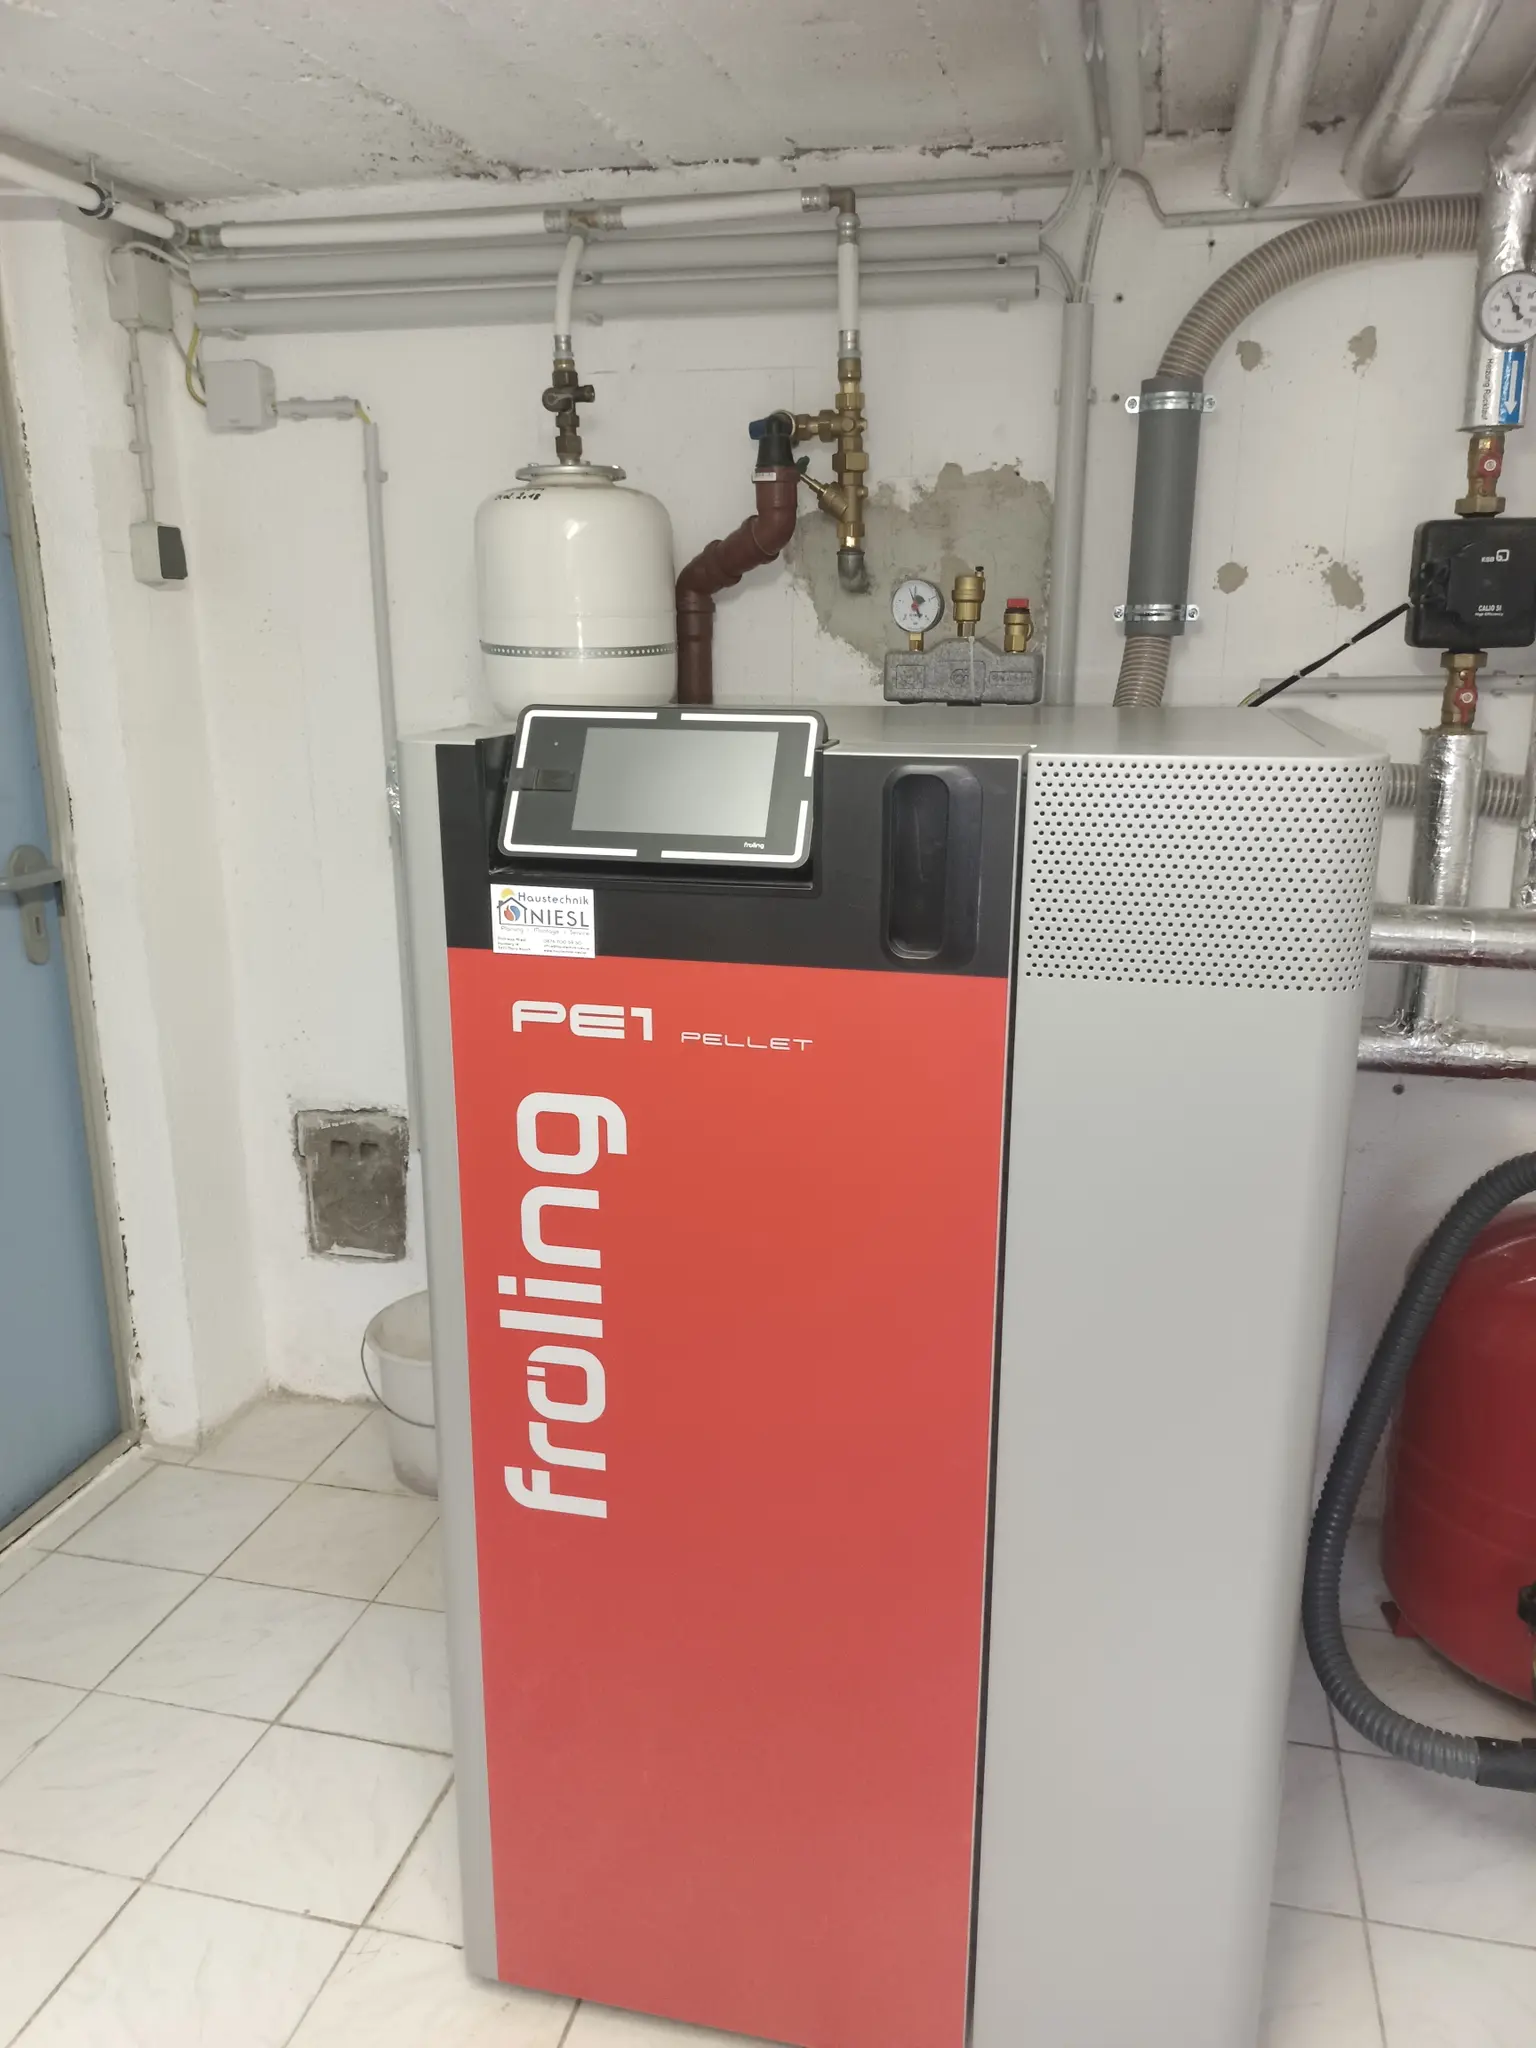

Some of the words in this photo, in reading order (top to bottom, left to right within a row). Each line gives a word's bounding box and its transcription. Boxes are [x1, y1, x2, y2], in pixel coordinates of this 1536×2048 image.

[518, 892, 589, 905] Haustechnik
[531, 909, 589, 927] NIESL
[511, 1000, 653, 1042] PE1
[681, 1031, 813, 1052] PELLET
